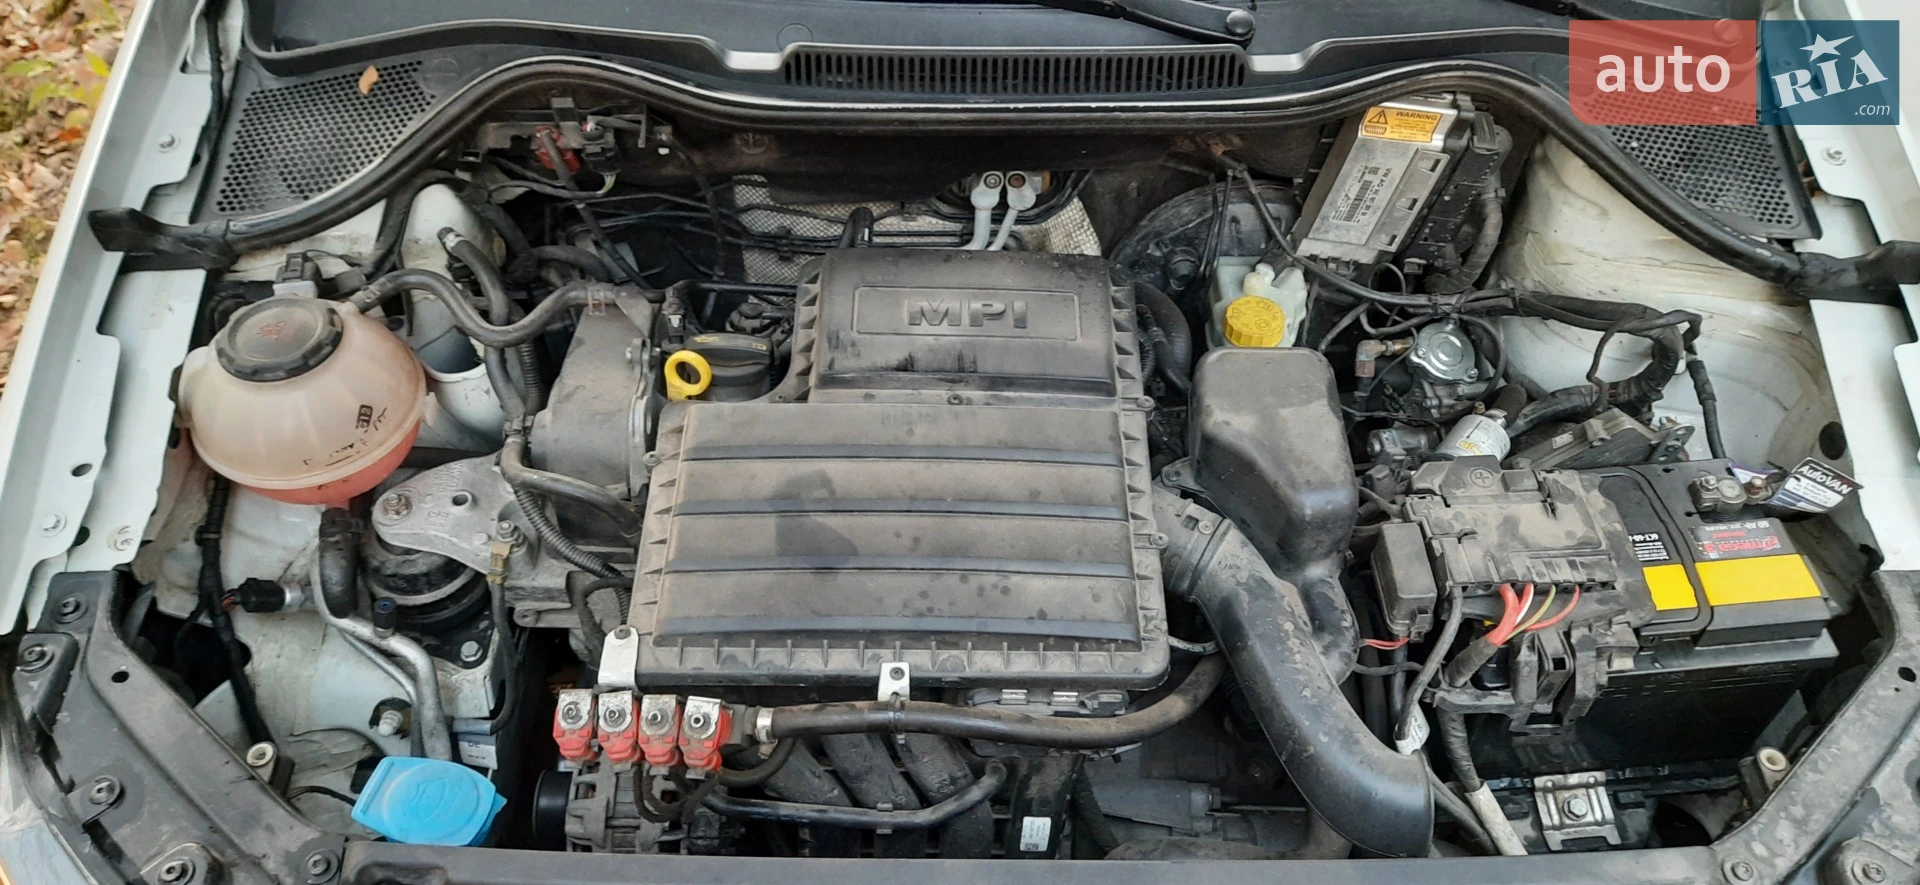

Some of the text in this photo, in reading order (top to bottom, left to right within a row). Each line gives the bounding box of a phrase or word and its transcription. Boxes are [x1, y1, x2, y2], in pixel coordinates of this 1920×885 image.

[1396, 110, 1438, 121] WARNING
[906, 299, 1028, 330] MPI
[1797, 464, 1854, 495] AutoVAN
